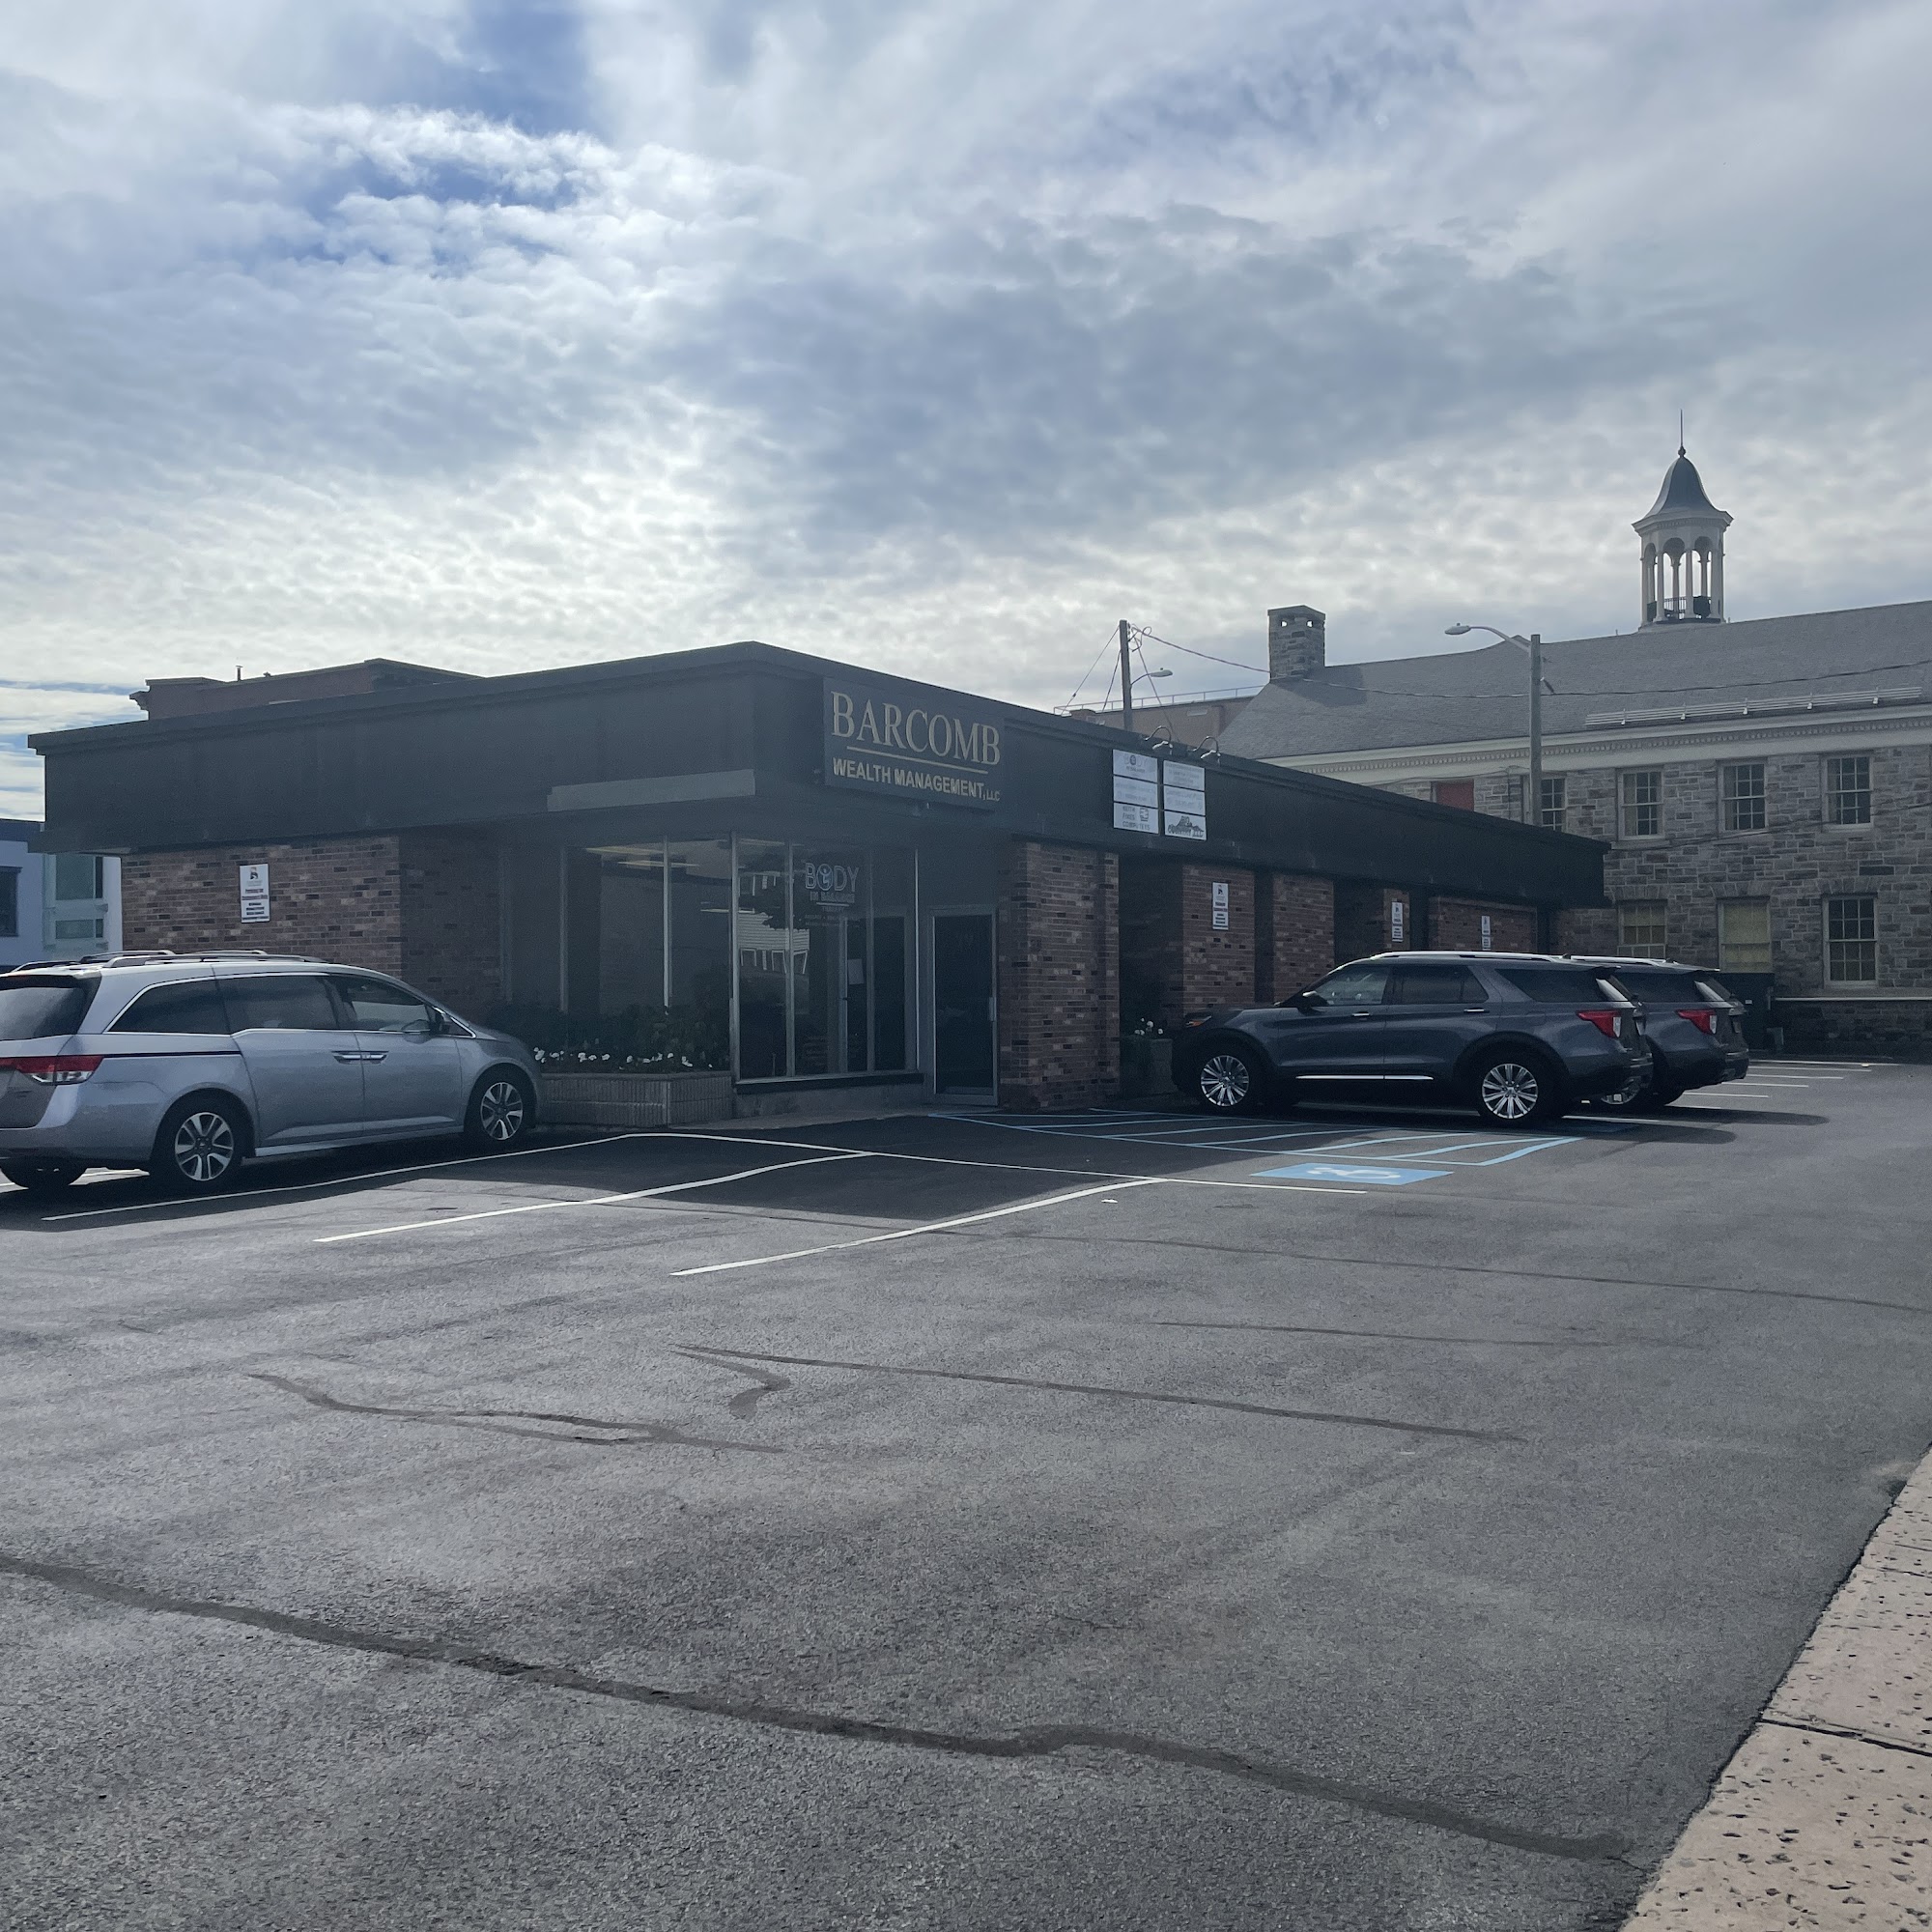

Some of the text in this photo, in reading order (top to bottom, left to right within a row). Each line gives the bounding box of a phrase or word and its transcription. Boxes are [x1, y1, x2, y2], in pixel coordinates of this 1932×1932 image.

[831, 691, 1001, 766] BARCOMB
[833, 757, 891, 784] WEALTH
[805, 862, 860, 893] BODY
